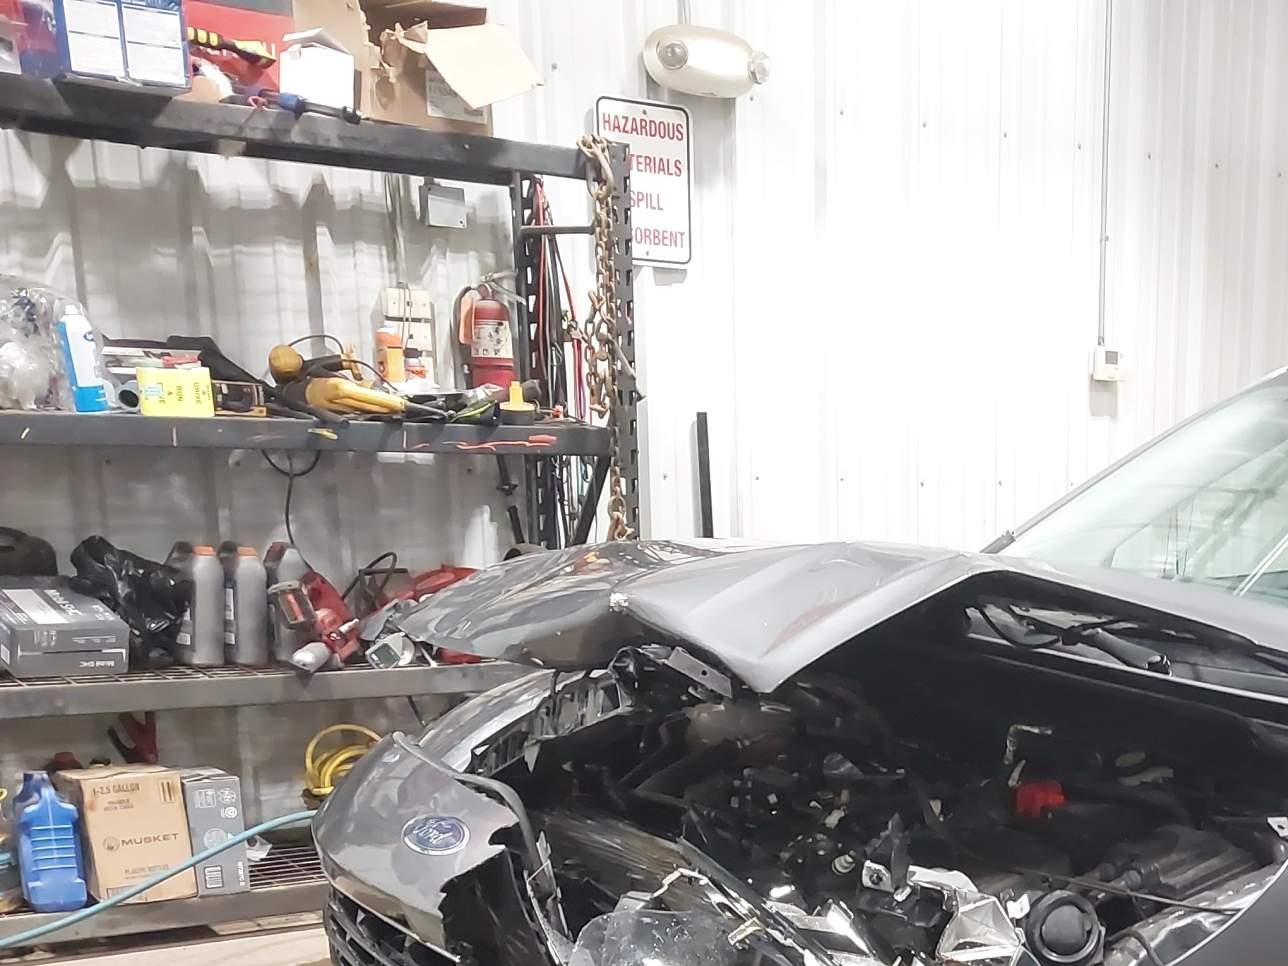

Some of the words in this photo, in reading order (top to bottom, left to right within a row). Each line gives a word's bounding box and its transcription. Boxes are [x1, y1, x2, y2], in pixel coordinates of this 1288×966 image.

[602, 112, 684, 142] HAZARDOUS
[629, 153, 682, 177] TERIALS
[632, 226, 686, 249] ORBENT
[112, 782, 141, 795] GALLON
[120, 832, 180, 847] MUSKET
[409, 817, 457, 846] Ford
